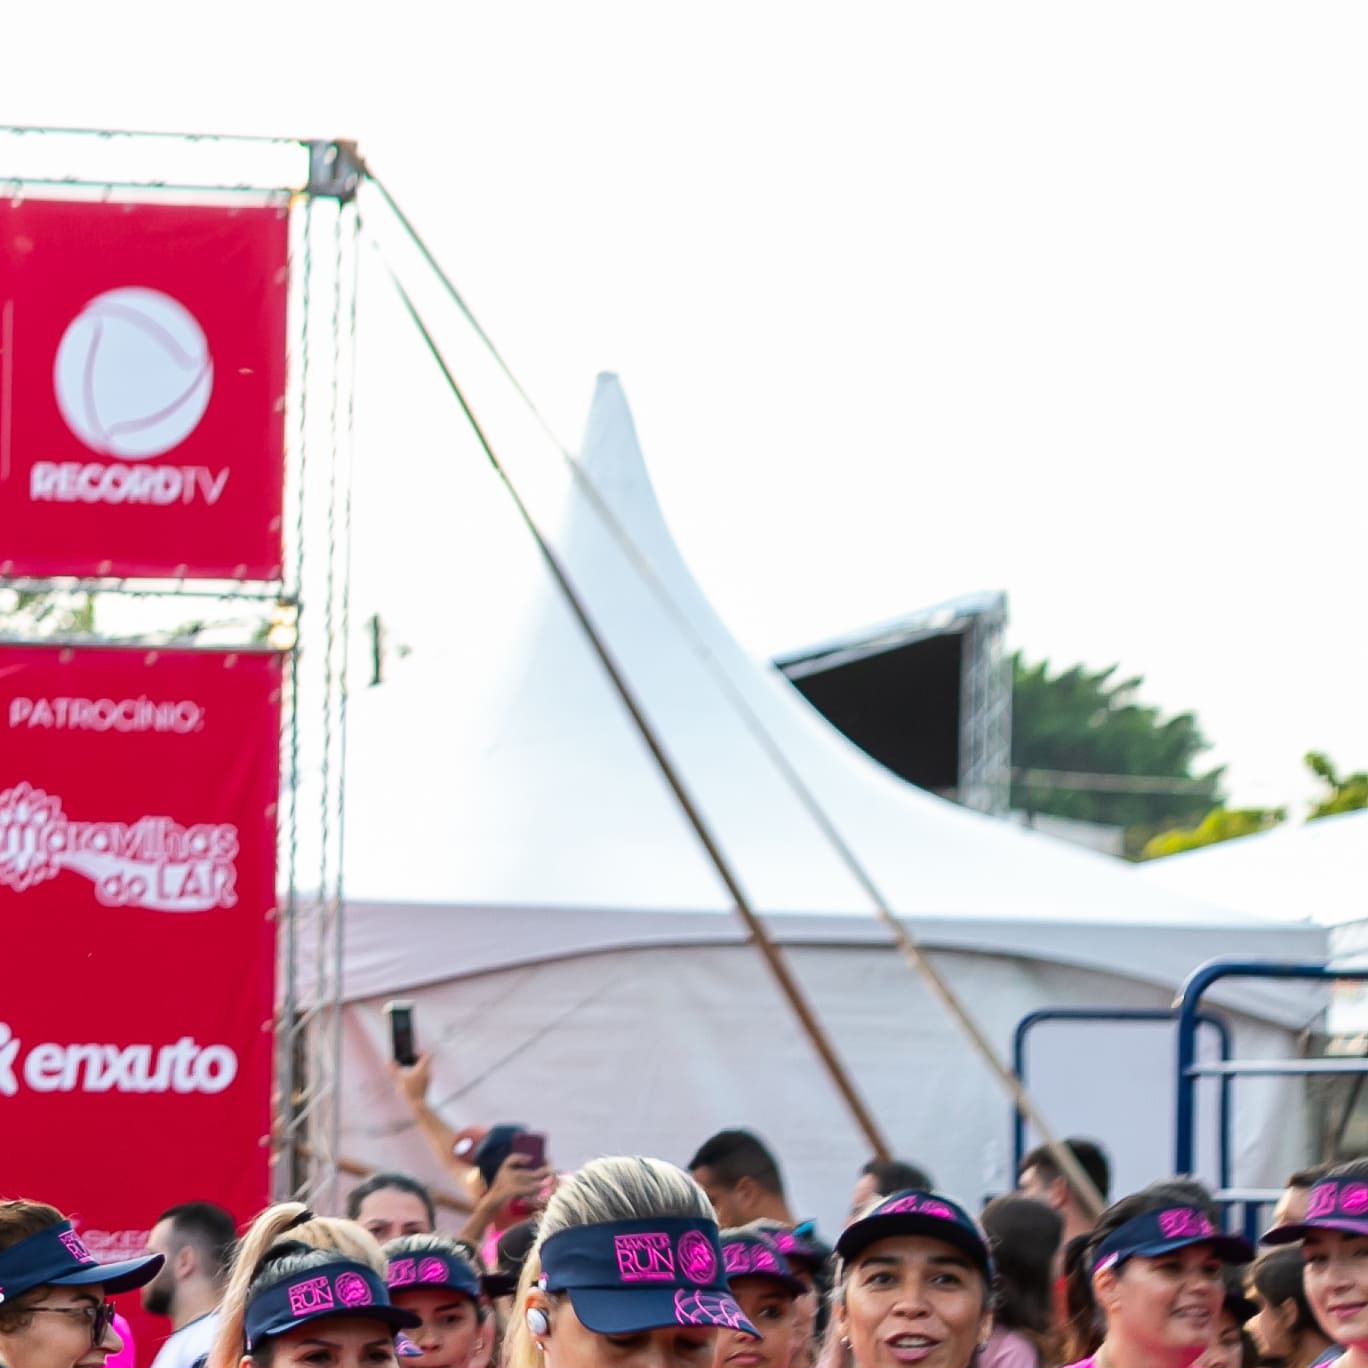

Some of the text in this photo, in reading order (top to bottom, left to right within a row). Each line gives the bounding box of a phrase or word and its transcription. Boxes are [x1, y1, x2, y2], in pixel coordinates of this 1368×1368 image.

[24, 1036, 238, 1094] enxuto
[617, 1248, 675, 1273] RUN
[291, 1286, 333, 1312] RUN
